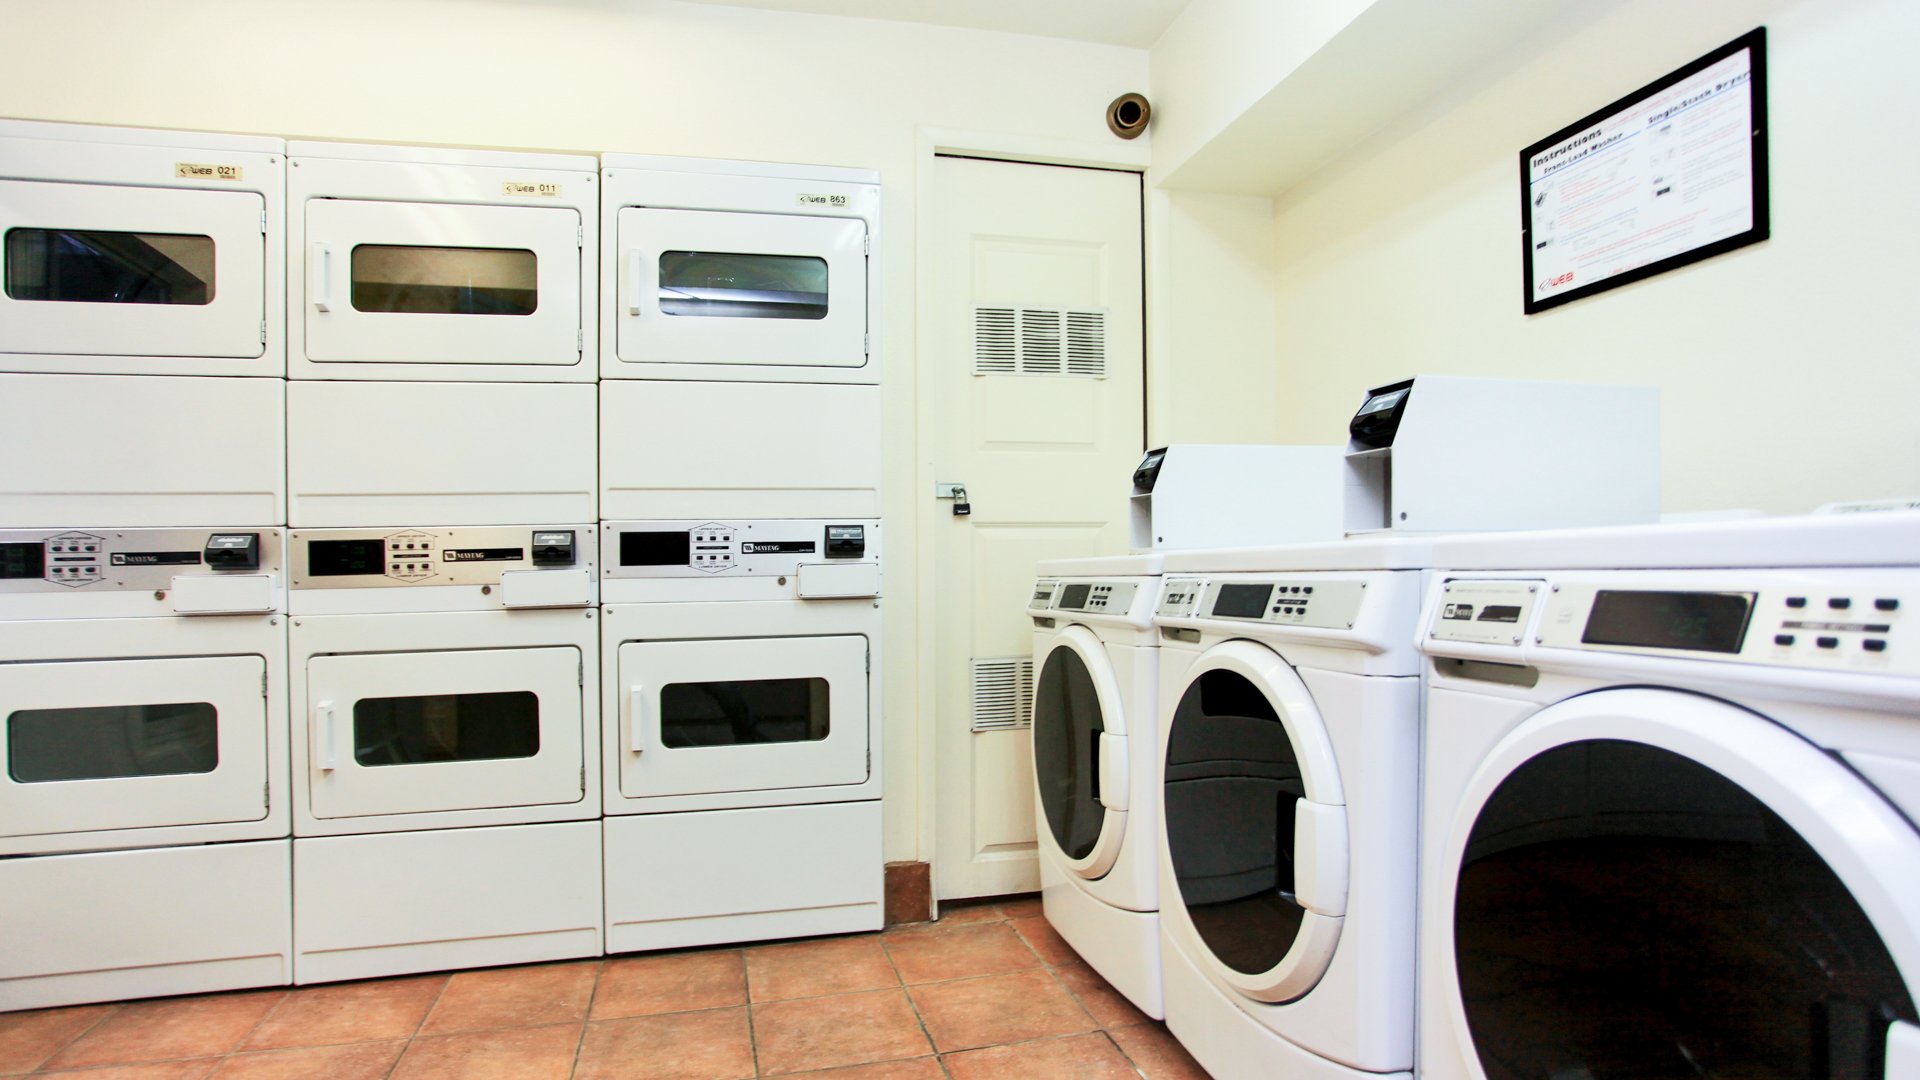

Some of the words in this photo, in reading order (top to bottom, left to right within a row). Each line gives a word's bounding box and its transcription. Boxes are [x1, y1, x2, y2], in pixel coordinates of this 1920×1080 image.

[1590, 132, 1623, 152] Washer
[1533, 129, 1602, 168] Instructions
[217, 166, 236, 175] 021
[539, 184, 556, 192] 011
[830, 195, 846, 204] 863
